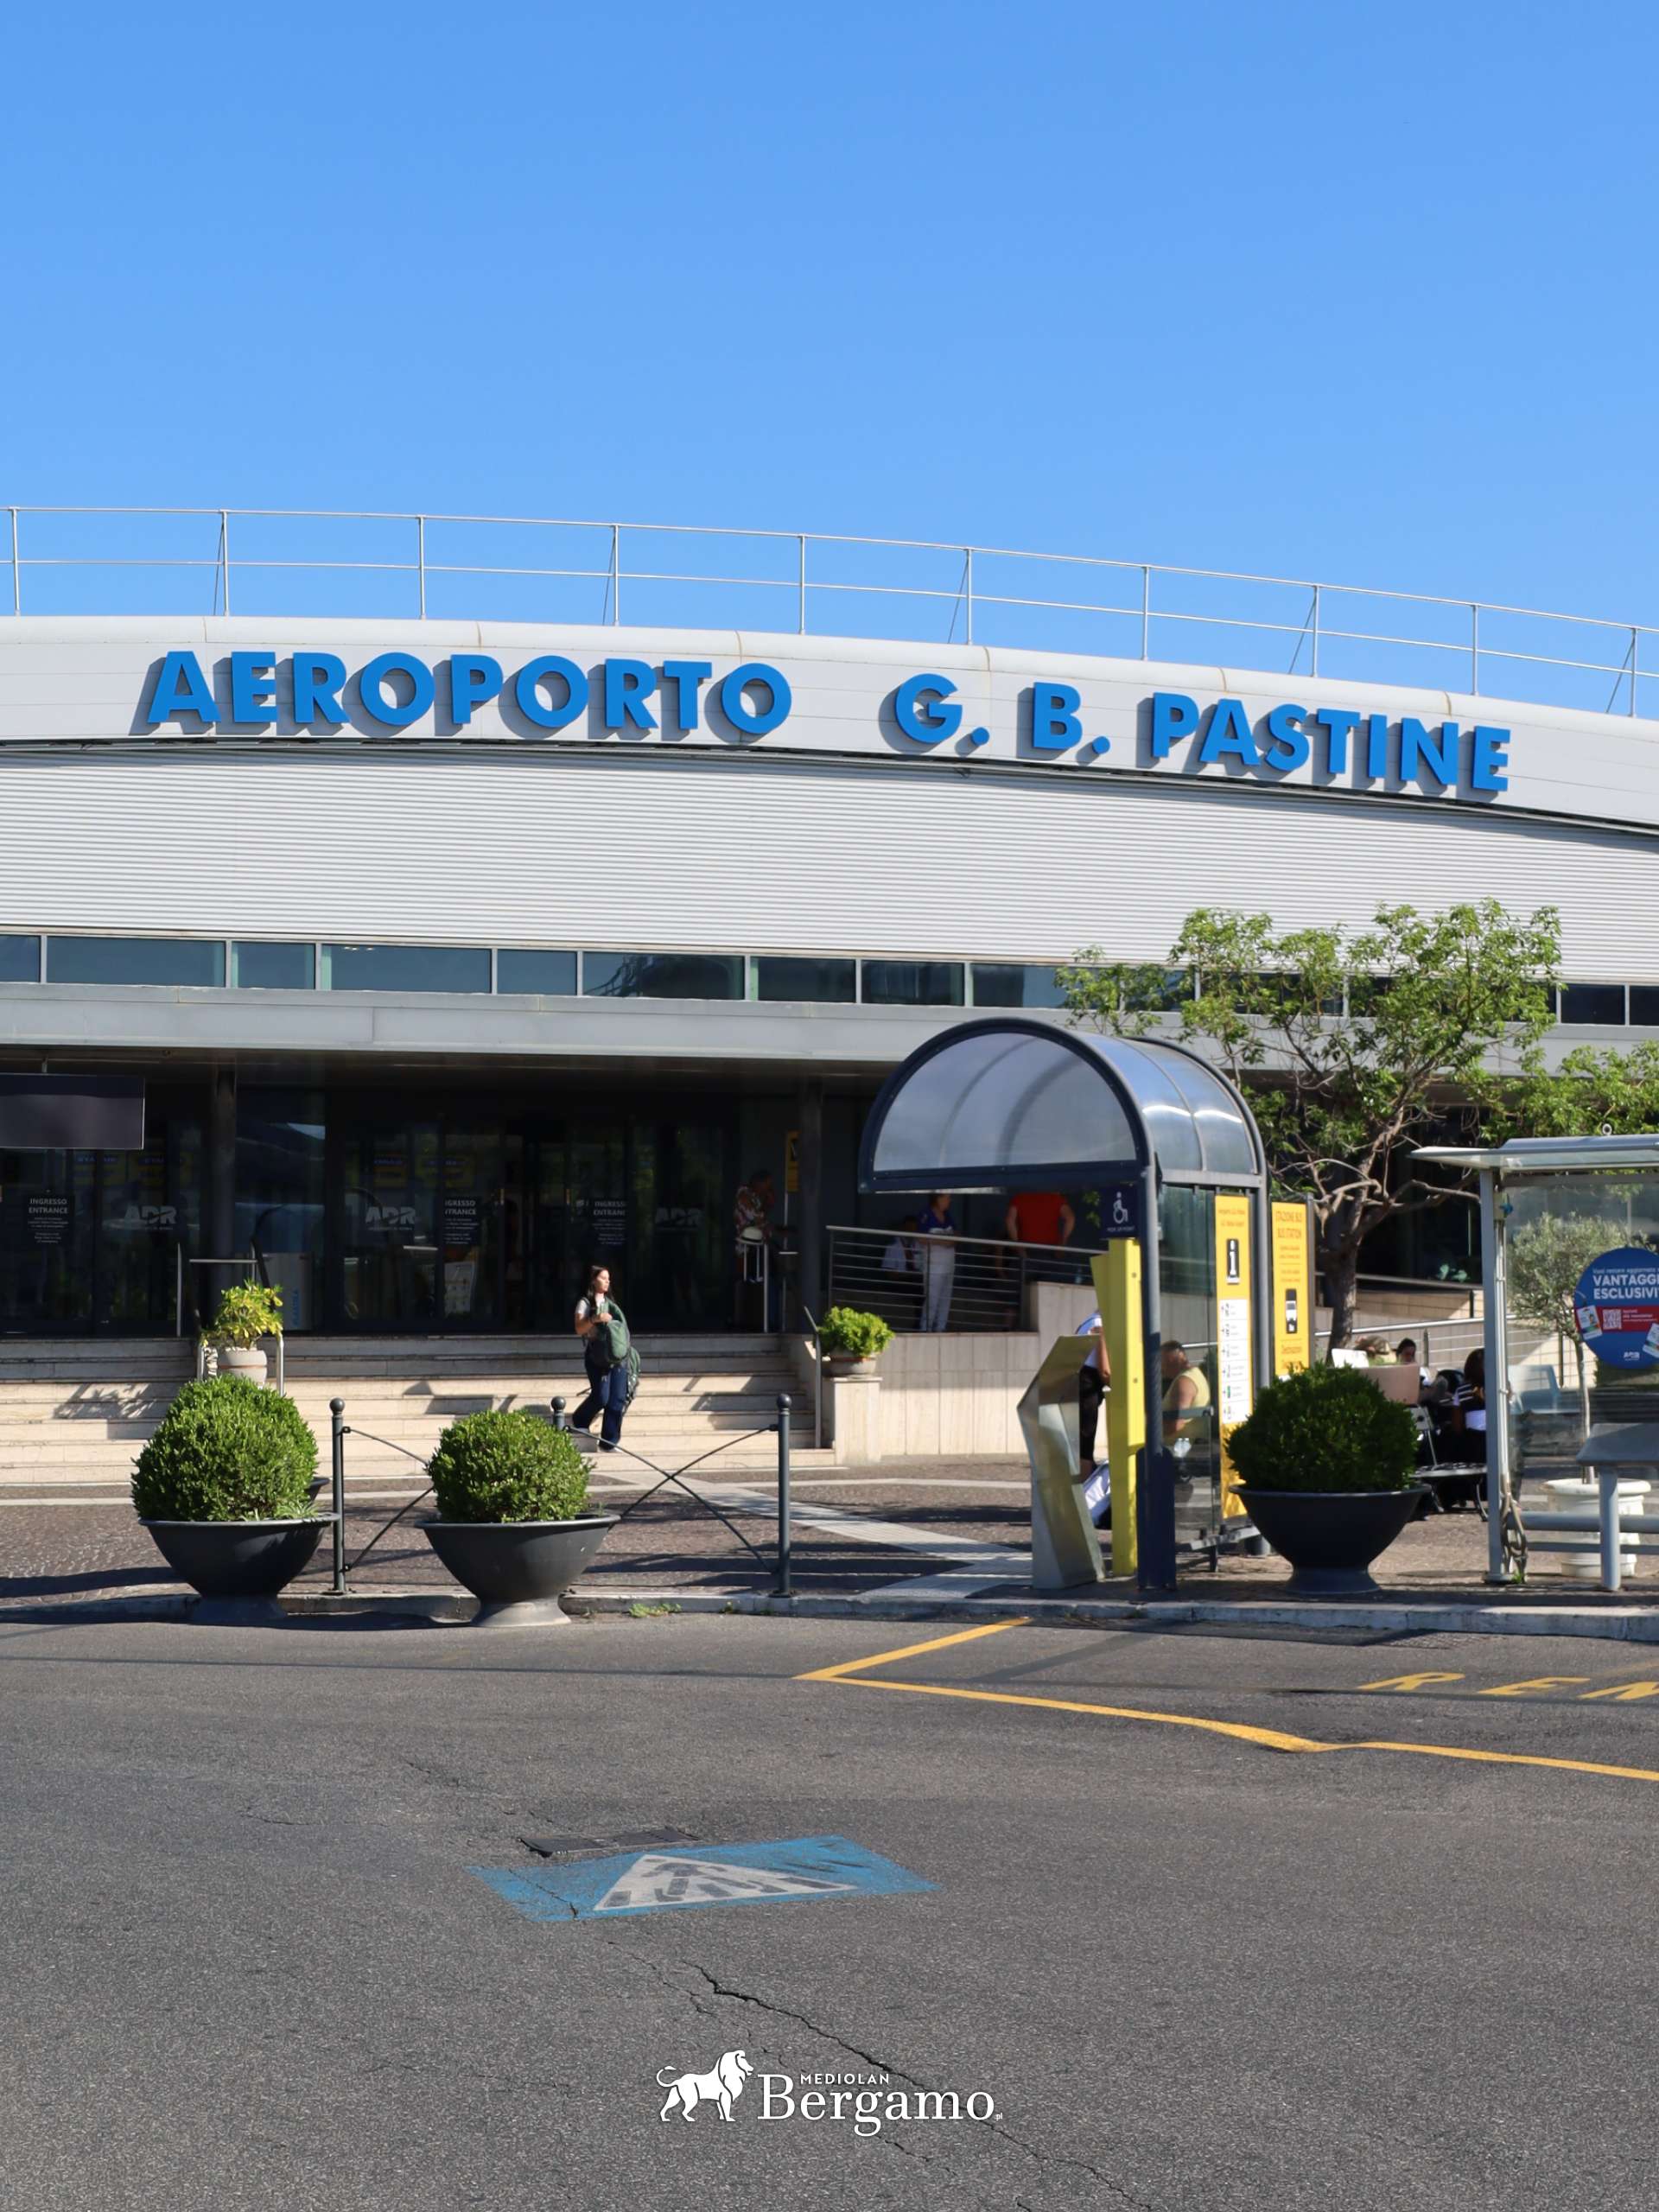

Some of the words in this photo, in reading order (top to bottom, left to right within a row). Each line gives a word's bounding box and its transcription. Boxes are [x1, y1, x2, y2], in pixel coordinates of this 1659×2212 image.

[148, 652, 792, 734] AEROPORTO
[895, 673, 988, 744] G.
[1033, 682, 1110, 753] B.
[1153, 692, 1510, 791] PASTINE
[124, 1205, 178, 1224] ADR
[365, 1205, 416, 1224] ADR
[1593, 1287, 1659, 1300] ESCLUSIVI
